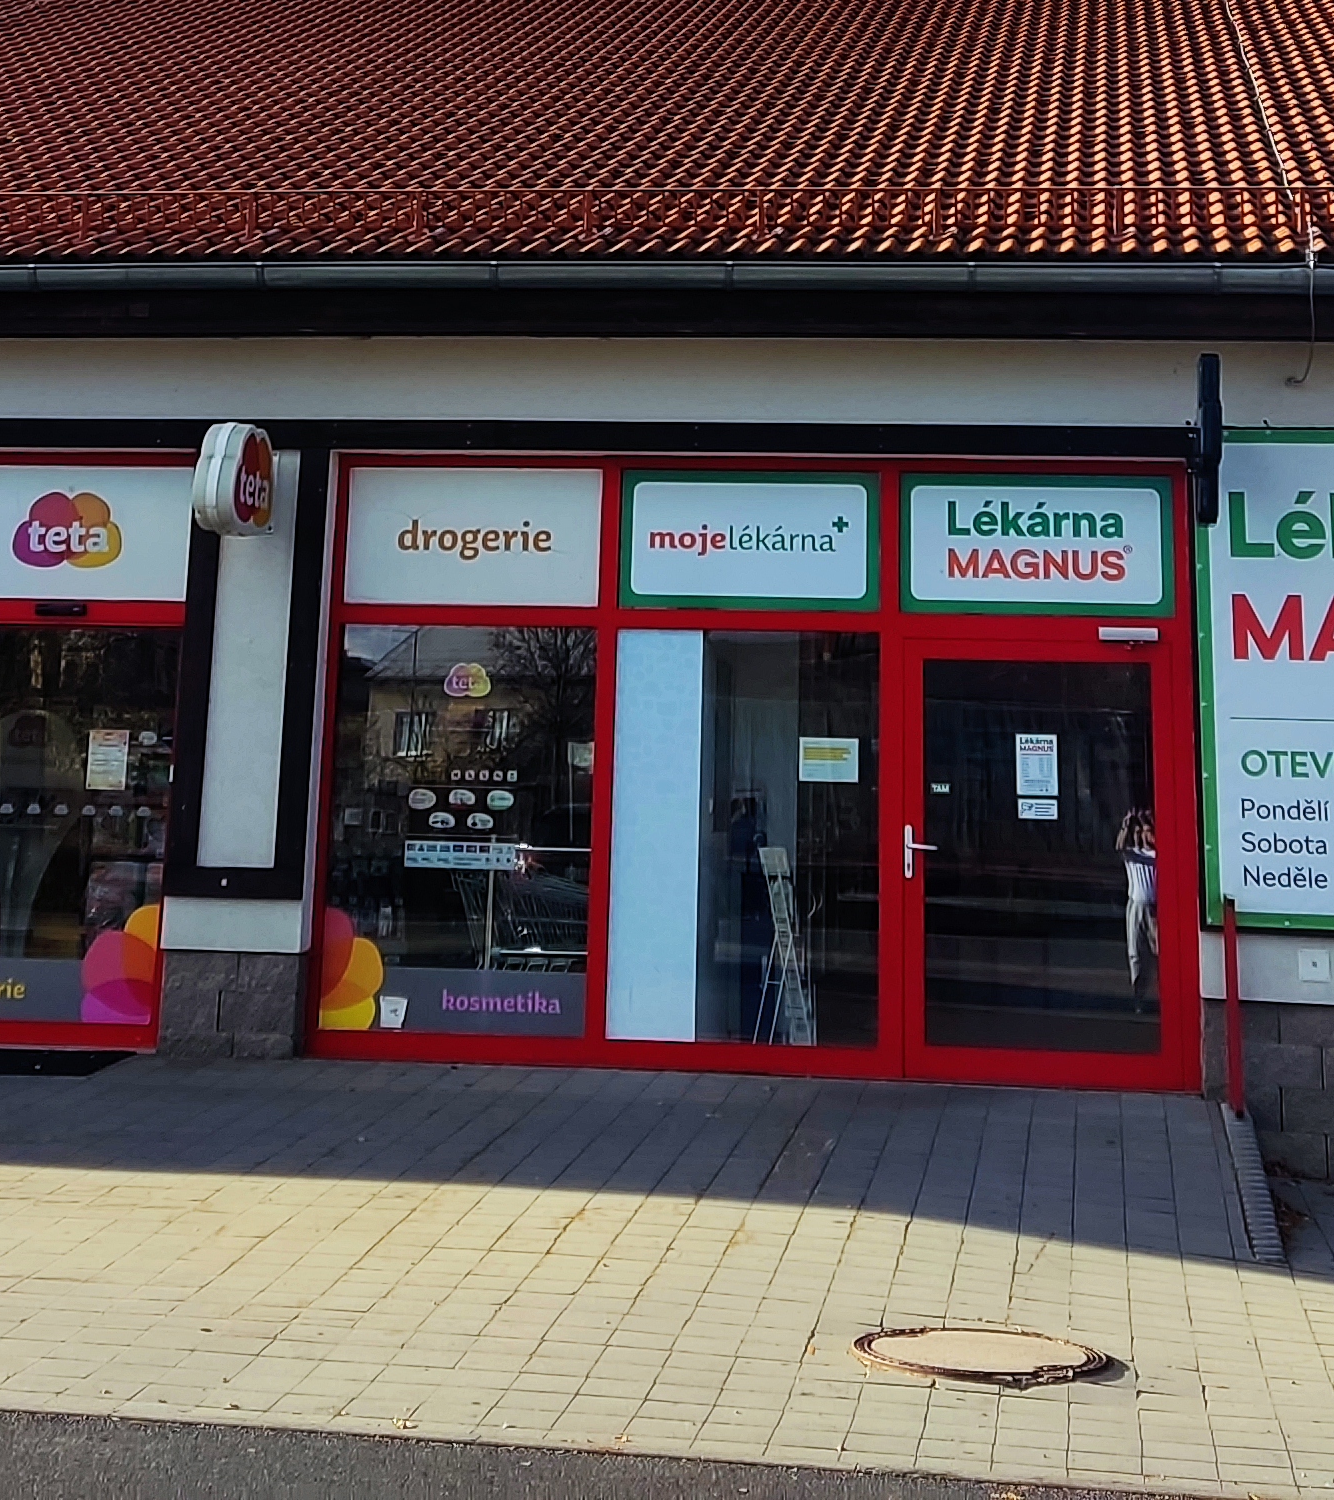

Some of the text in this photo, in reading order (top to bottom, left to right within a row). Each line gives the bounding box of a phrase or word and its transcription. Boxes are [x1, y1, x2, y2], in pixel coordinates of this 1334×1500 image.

[239, 464, 269, 508] teta
[947, 500, 1124, 539] Lékárna
[27, 519, 109, 554] teta
[396, 519, 553, 561] drogerie
[649, 522, 837, 557] mojelékárna
[452, 676, 482, 689] tet
[1240, 797, 1330, 823] Pondělí
[1240, 831, 1328, 856] Sobota
[1242, 864, 1329, 889] Neděle
[441, 989, 562, 1015] kosmetika
